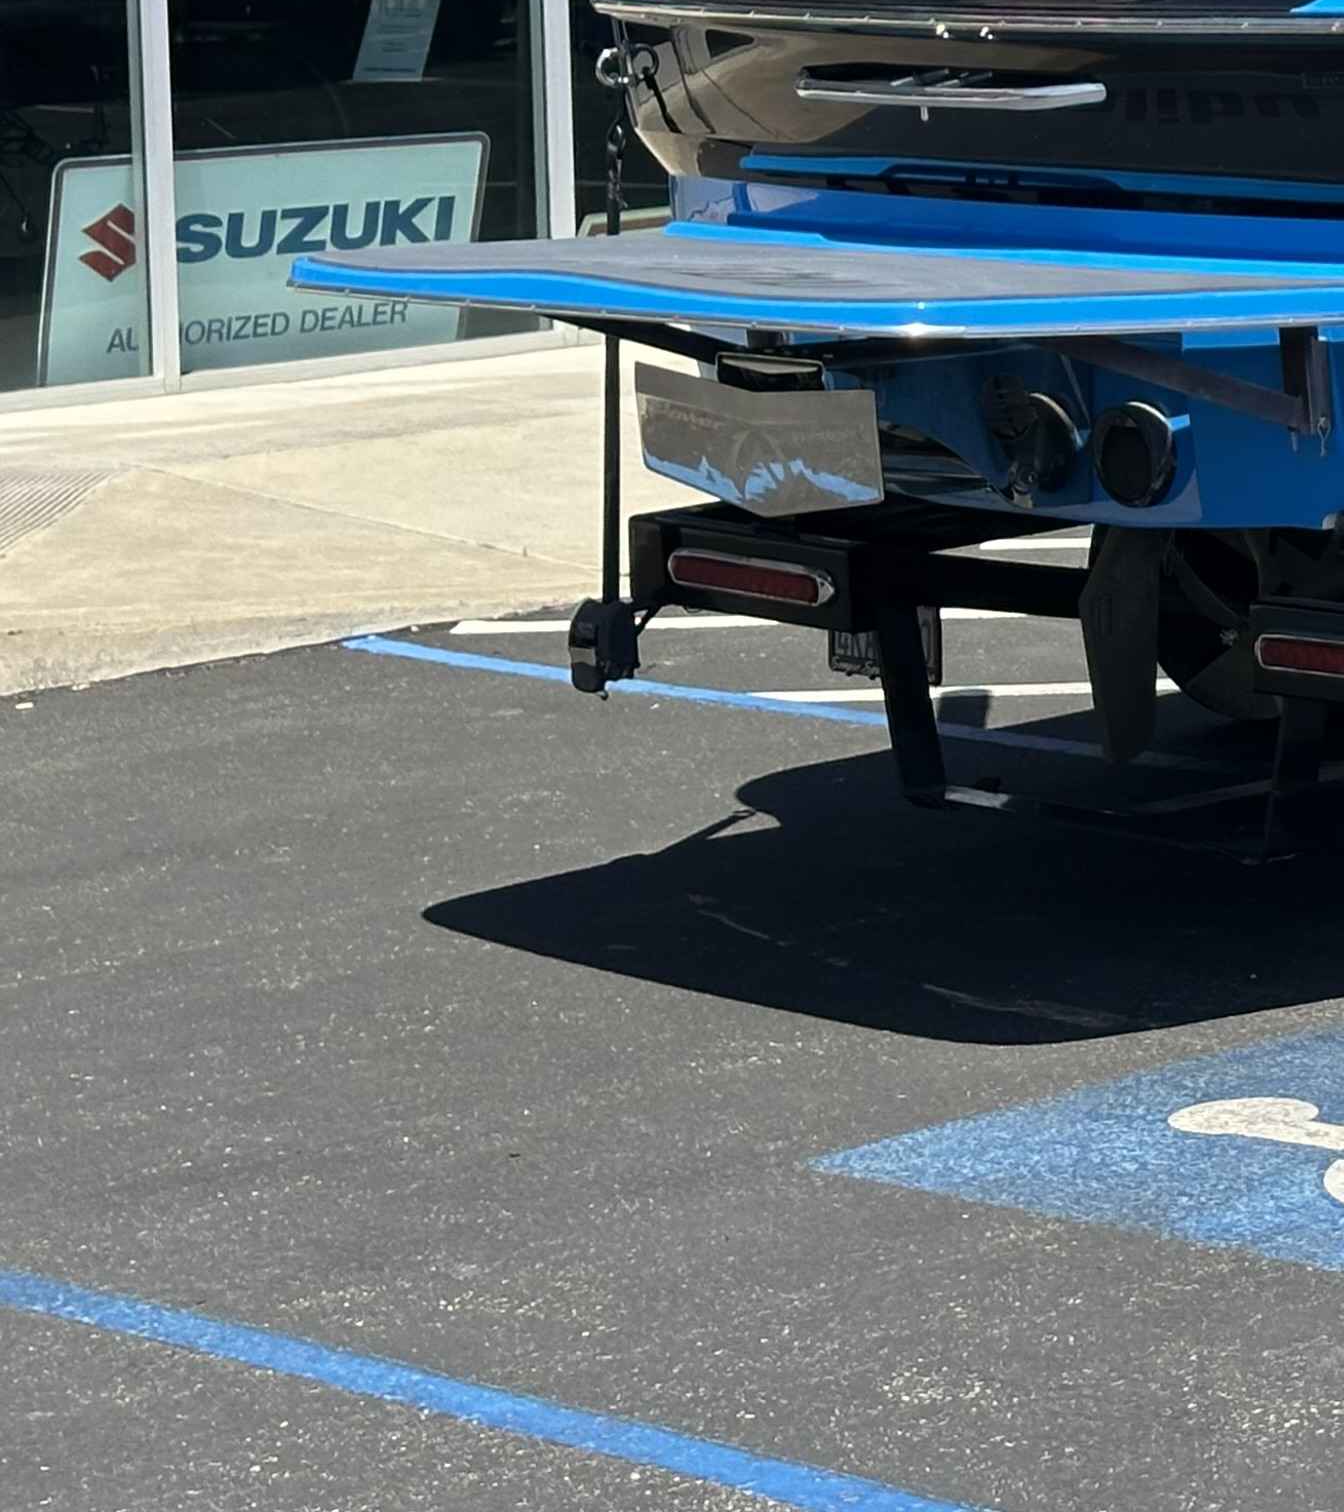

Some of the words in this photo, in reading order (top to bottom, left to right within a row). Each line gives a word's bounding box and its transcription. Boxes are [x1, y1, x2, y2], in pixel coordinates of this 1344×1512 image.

[175, 194, 456, 264] SUZUKI
[106, 310, 291, 355] AUORIZED
[299, 300, 409, 335] DEALER
